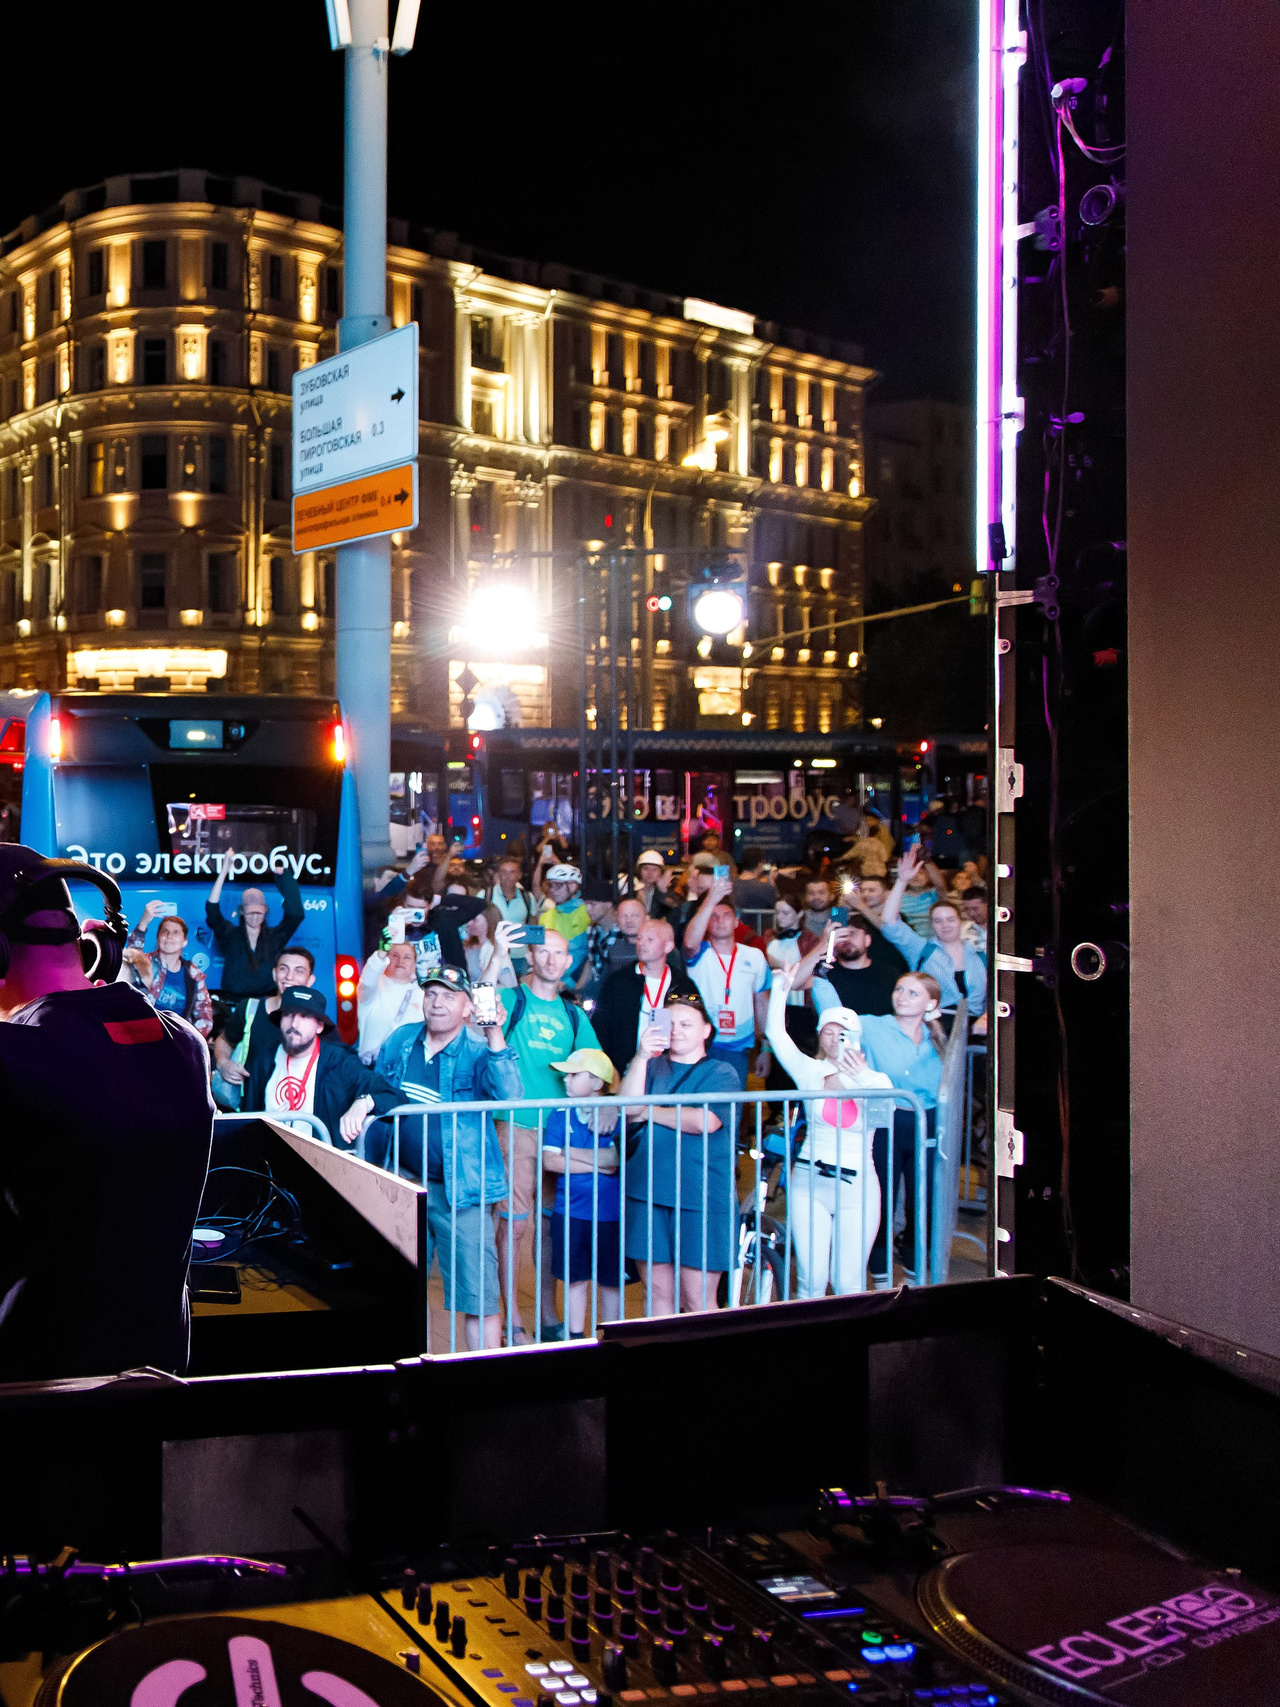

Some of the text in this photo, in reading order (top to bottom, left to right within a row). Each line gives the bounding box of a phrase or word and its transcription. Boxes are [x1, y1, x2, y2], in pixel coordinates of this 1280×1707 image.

[300, 364, 349, 395] ЗУБОВСКАЯ
[300, 394, 324, 416] улица
[300, 417, 343, 443] БОЛЬШАЯ
[300, 430, 362, 462] ПИРОГОВСКАЯ
[300, 462, 324, 482] улица
[66, 844, 331, 881] Это электробус.
[303, 899, 328, 911] 649
